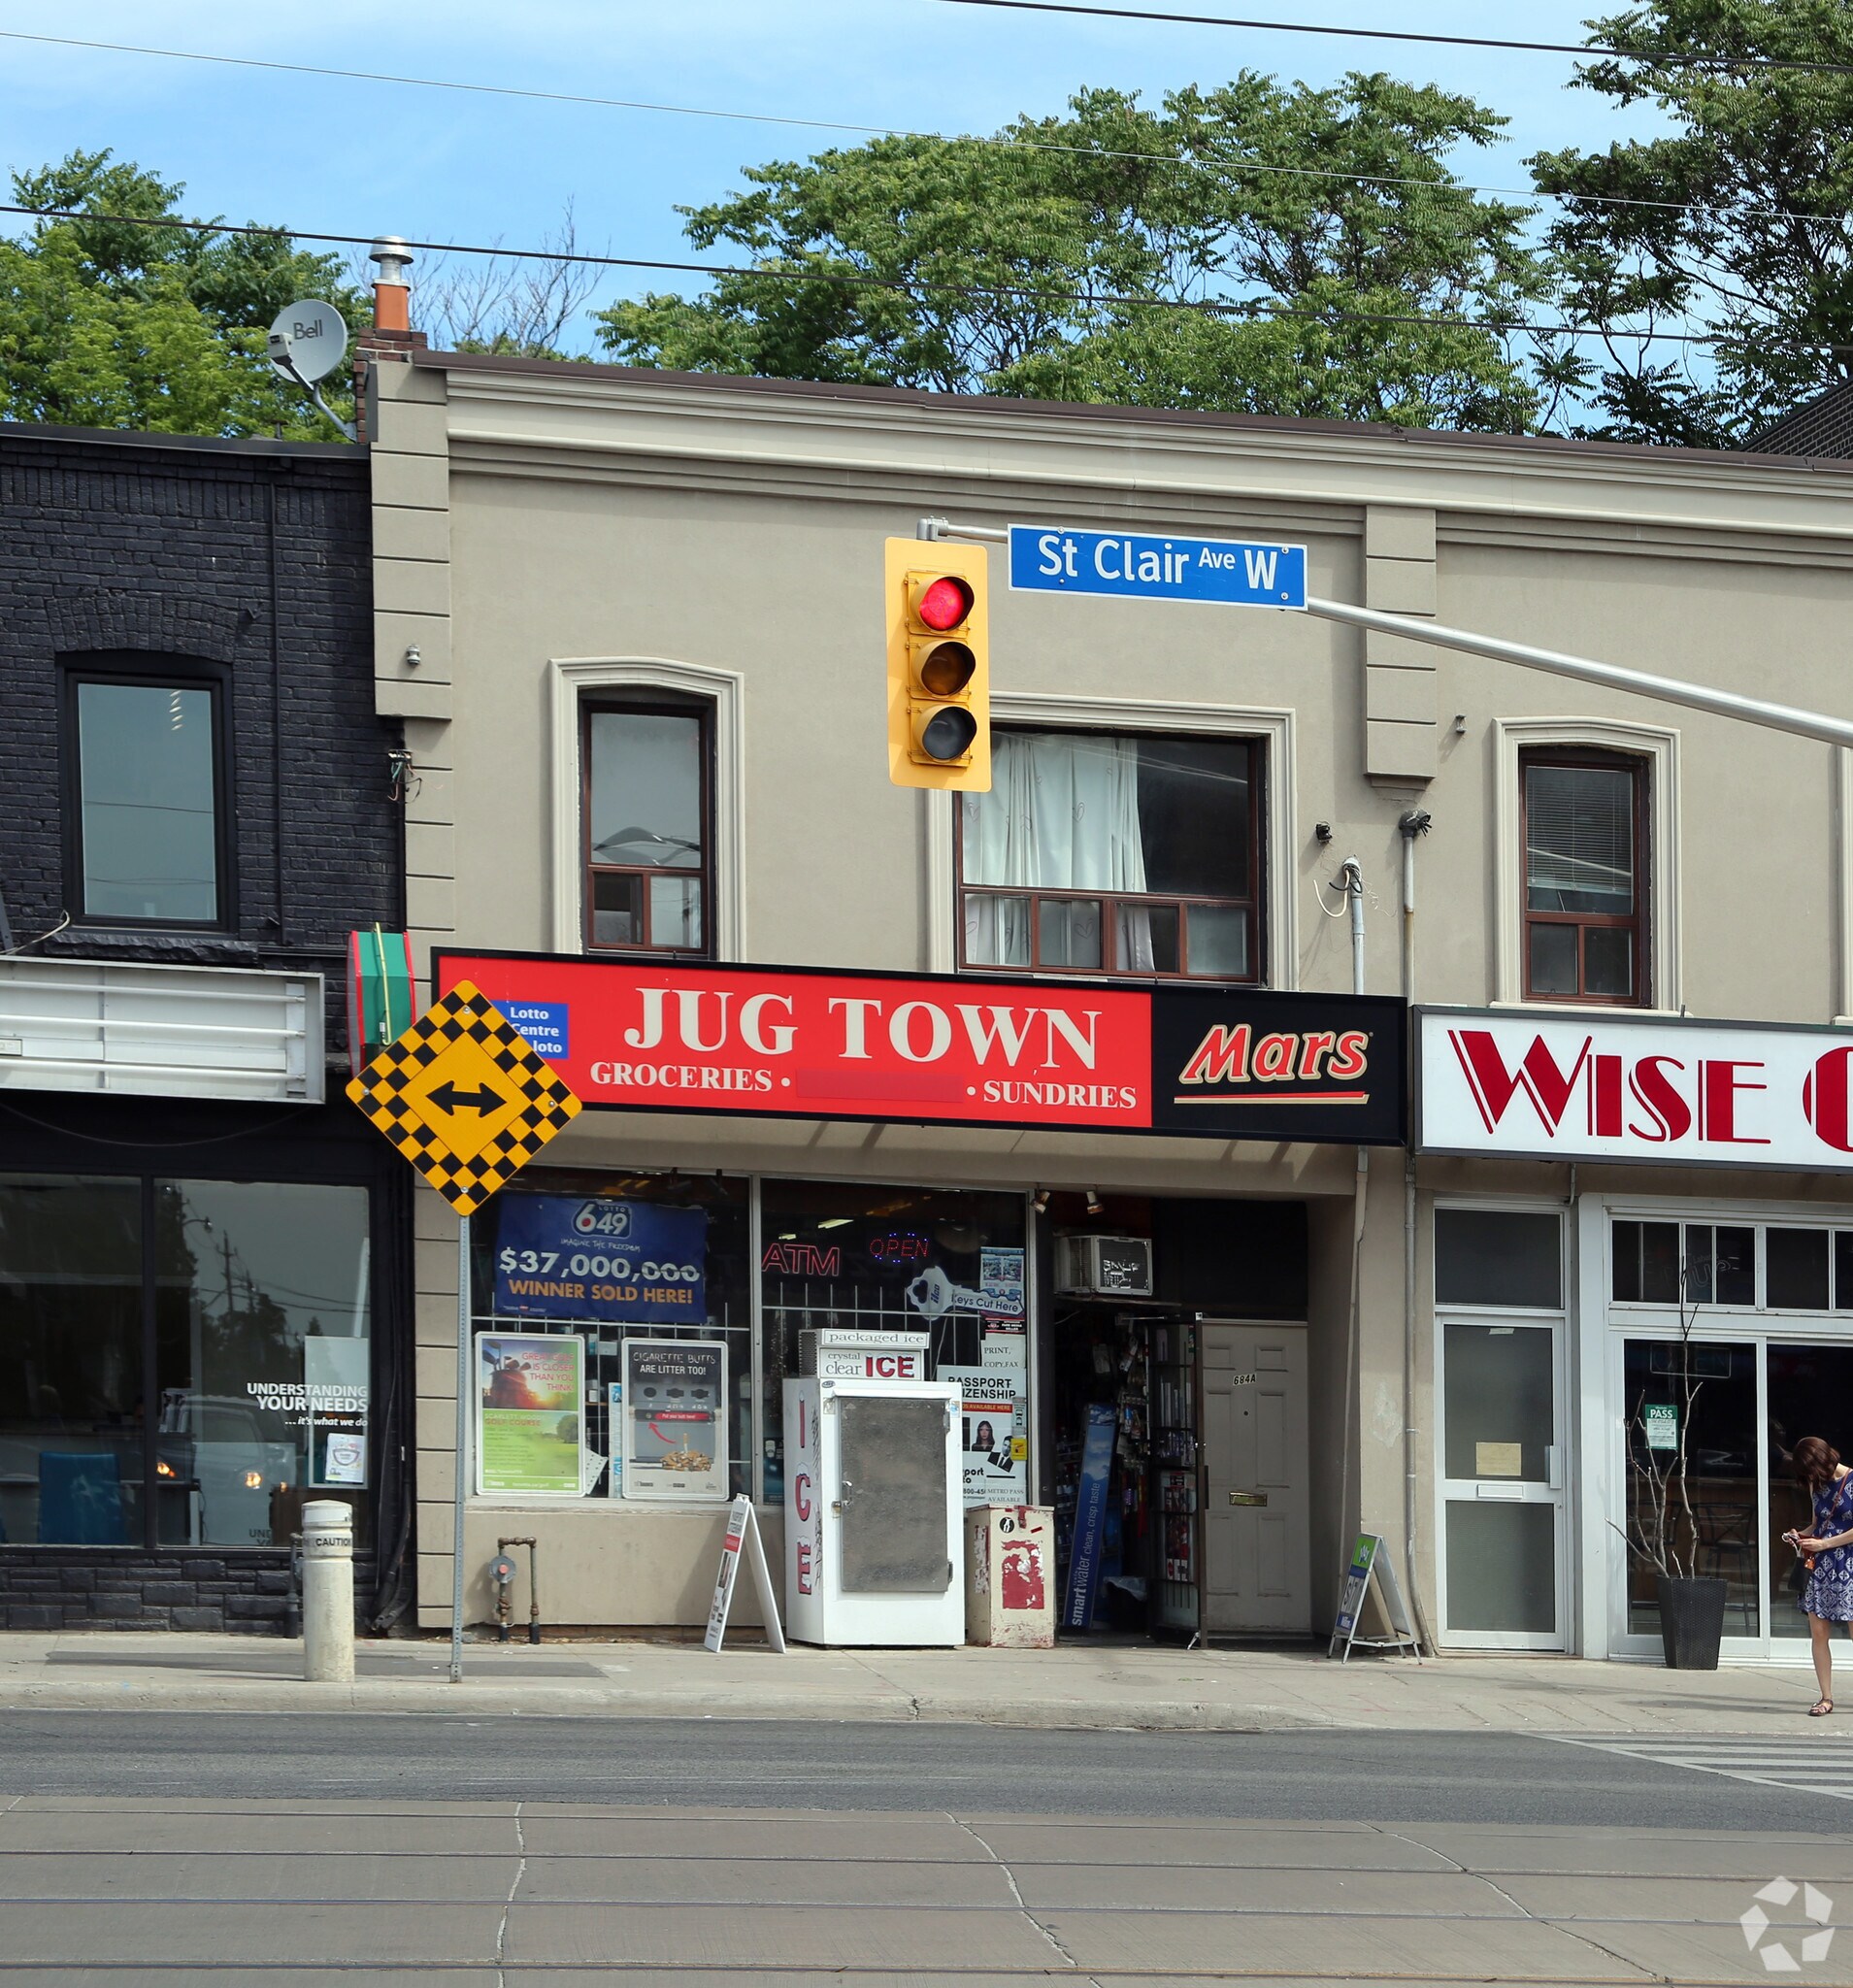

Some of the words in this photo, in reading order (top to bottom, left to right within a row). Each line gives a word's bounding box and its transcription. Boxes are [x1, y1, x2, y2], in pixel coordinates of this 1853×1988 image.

[293, 319, 323, 340] Bell
[1038, 535, 1078, 578] St
[1094, 539, 1190, 584] Clair
[1198, 547, 1236, 570] Ave
[1243, 549, 1278, 590] W
[510, 1006, 549, 1020] Lotto
[624, 987, 799, 1055] JUG
[828, 997, 1103, 1070] TOWN
[1178, 1023, 1369, 1084] Mars
[590, 1062, 773, 1092] GROCERIES
[983, 1079, 1137, 1110] SUNDRIES
[1447, 1030, 1771, 1143] WISE
[592, 1240, 607, 1249] THE
[870, 1239, 929, 1257] OPEN
[499, 1246, 701, 1282] $37,000,000
[761, 1242, 840, 1276] ATM
[508, 1279, 585, 1299] WINNER
[591, 1284, 638, 1302] SOLD
[643, 1287, 693, 1304] HERE!
[976, 1299, 994, 1308] Cut
[996, 1301, 1018, 1312] Here
[830, 1333, 899, 1343] packaged
[904, 1335, 924, 1343] ice
[542, 1363, 575, 1372] CLOSER
[633, 1352, 683, 1364] CIGARETTE
[688, 1354, 716, 1365] BUTTS
[826, 1361, 862, 1375] clear
[865, 1353, 914, 1377] ICE
[640, 1365, 656, 1374] ARE
[658, 1365, 685, 1375] LITTER
[687, 1367, 707, 1375] TOO!
[1234, 1374, 1256, 1385] 684A
[247, 1383, 368, 1397] UNDERSTANDING
[962, 1388, 1016, 1399] IZENSHIP
[255, 1396, 307, 1410] YOUR
[311, 1398, 368, 1412] NEEDS
[1650, 1409, 1672, 1418] PASS
[298, 1416, 312, 1425] it's
[314, 1417, 338, 1426] what
[355, 1418, 368, 1427] do
[795, 1390, 811, 1595] ICE
[1090, 1482, 1100, 1504] taste
[1087, 1507, 1098, 1527] crisp
[1083, 1530, 1095, 1554] clean,
[1072, 1555, 1090, 1626] smartwater
